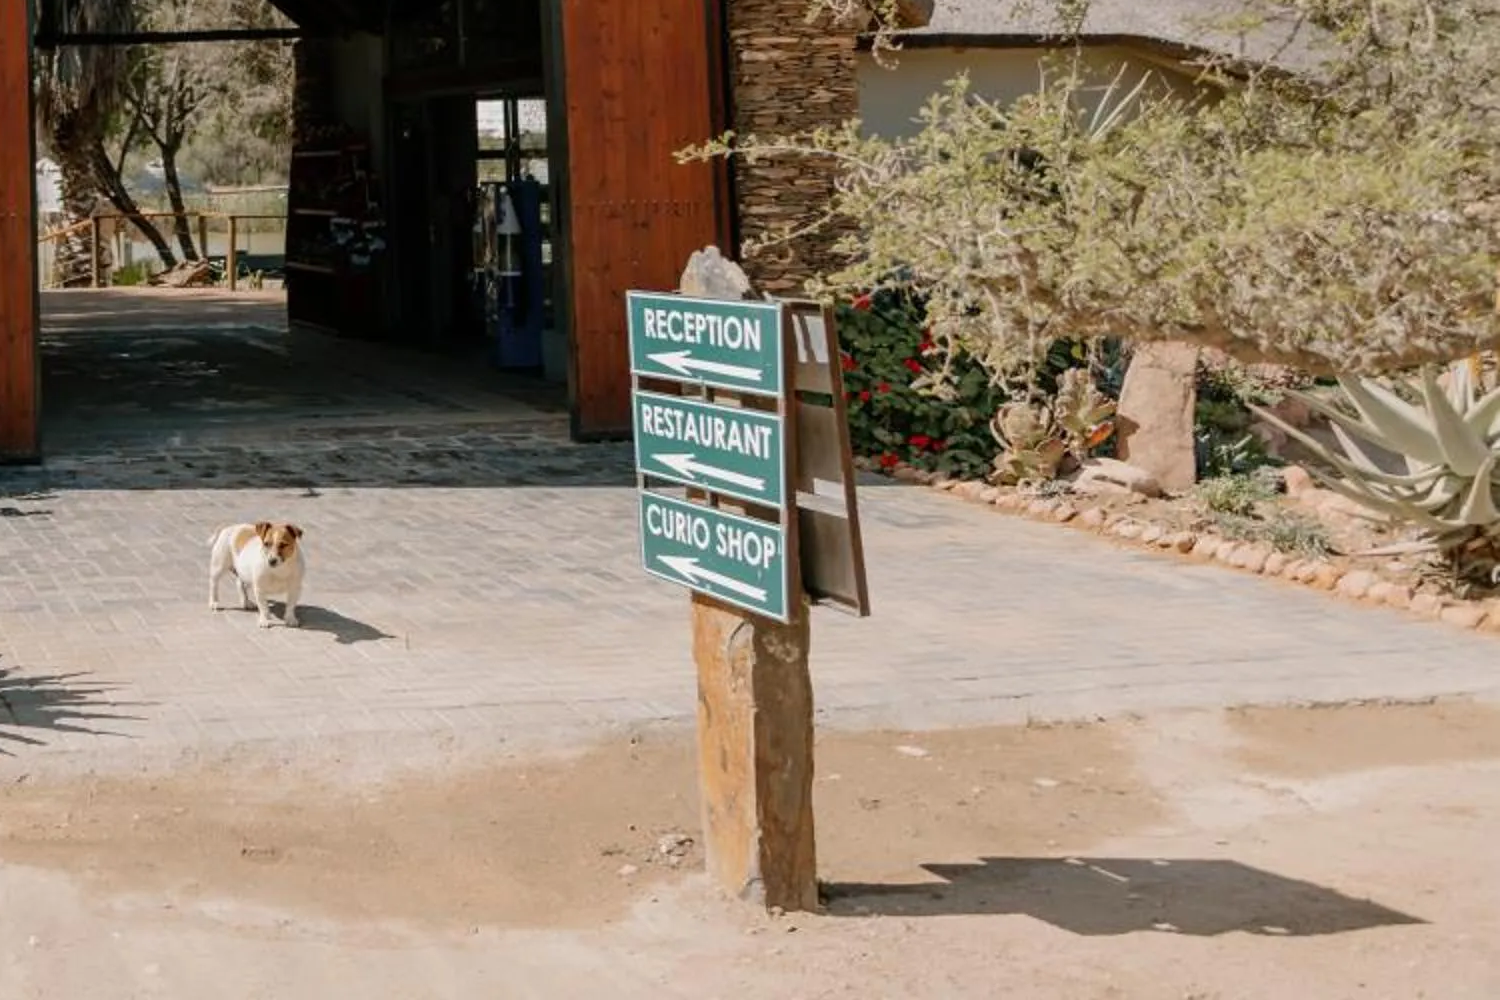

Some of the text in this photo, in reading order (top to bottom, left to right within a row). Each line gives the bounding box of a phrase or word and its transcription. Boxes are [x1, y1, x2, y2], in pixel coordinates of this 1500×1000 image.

[644, 308, 761, 350] RECEPTION
[643, 405, 771, 459] RESTAURANT
[647, 505, 775, 569] CURIO SHOP
